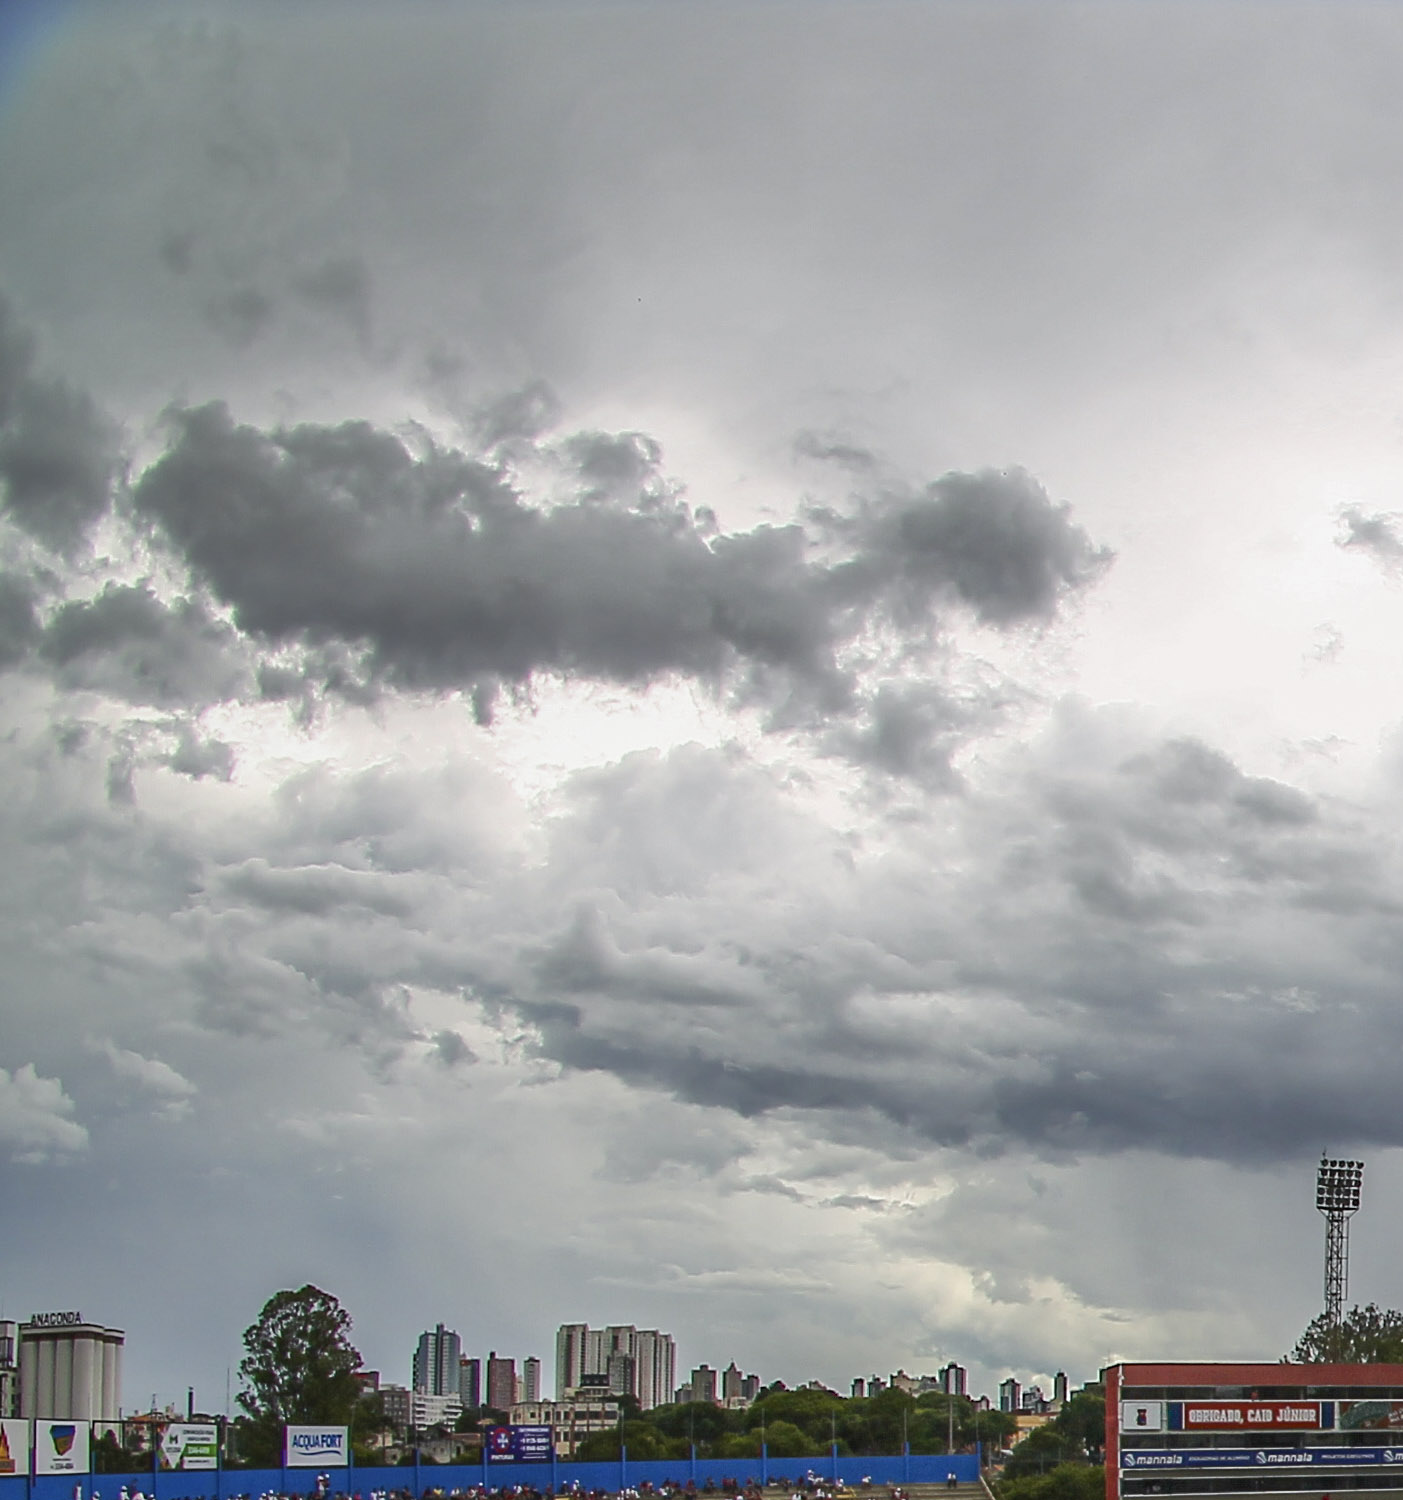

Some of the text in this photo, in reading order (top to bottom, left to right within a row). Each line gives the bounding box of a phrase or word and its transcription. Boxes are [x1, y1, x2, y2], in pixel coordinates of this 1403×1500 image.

[31, 1311, 82, 1326] ANACONDA
[1188, 1406, 1317, 1424] OBRIGADO, CAIO JÚNIOR
